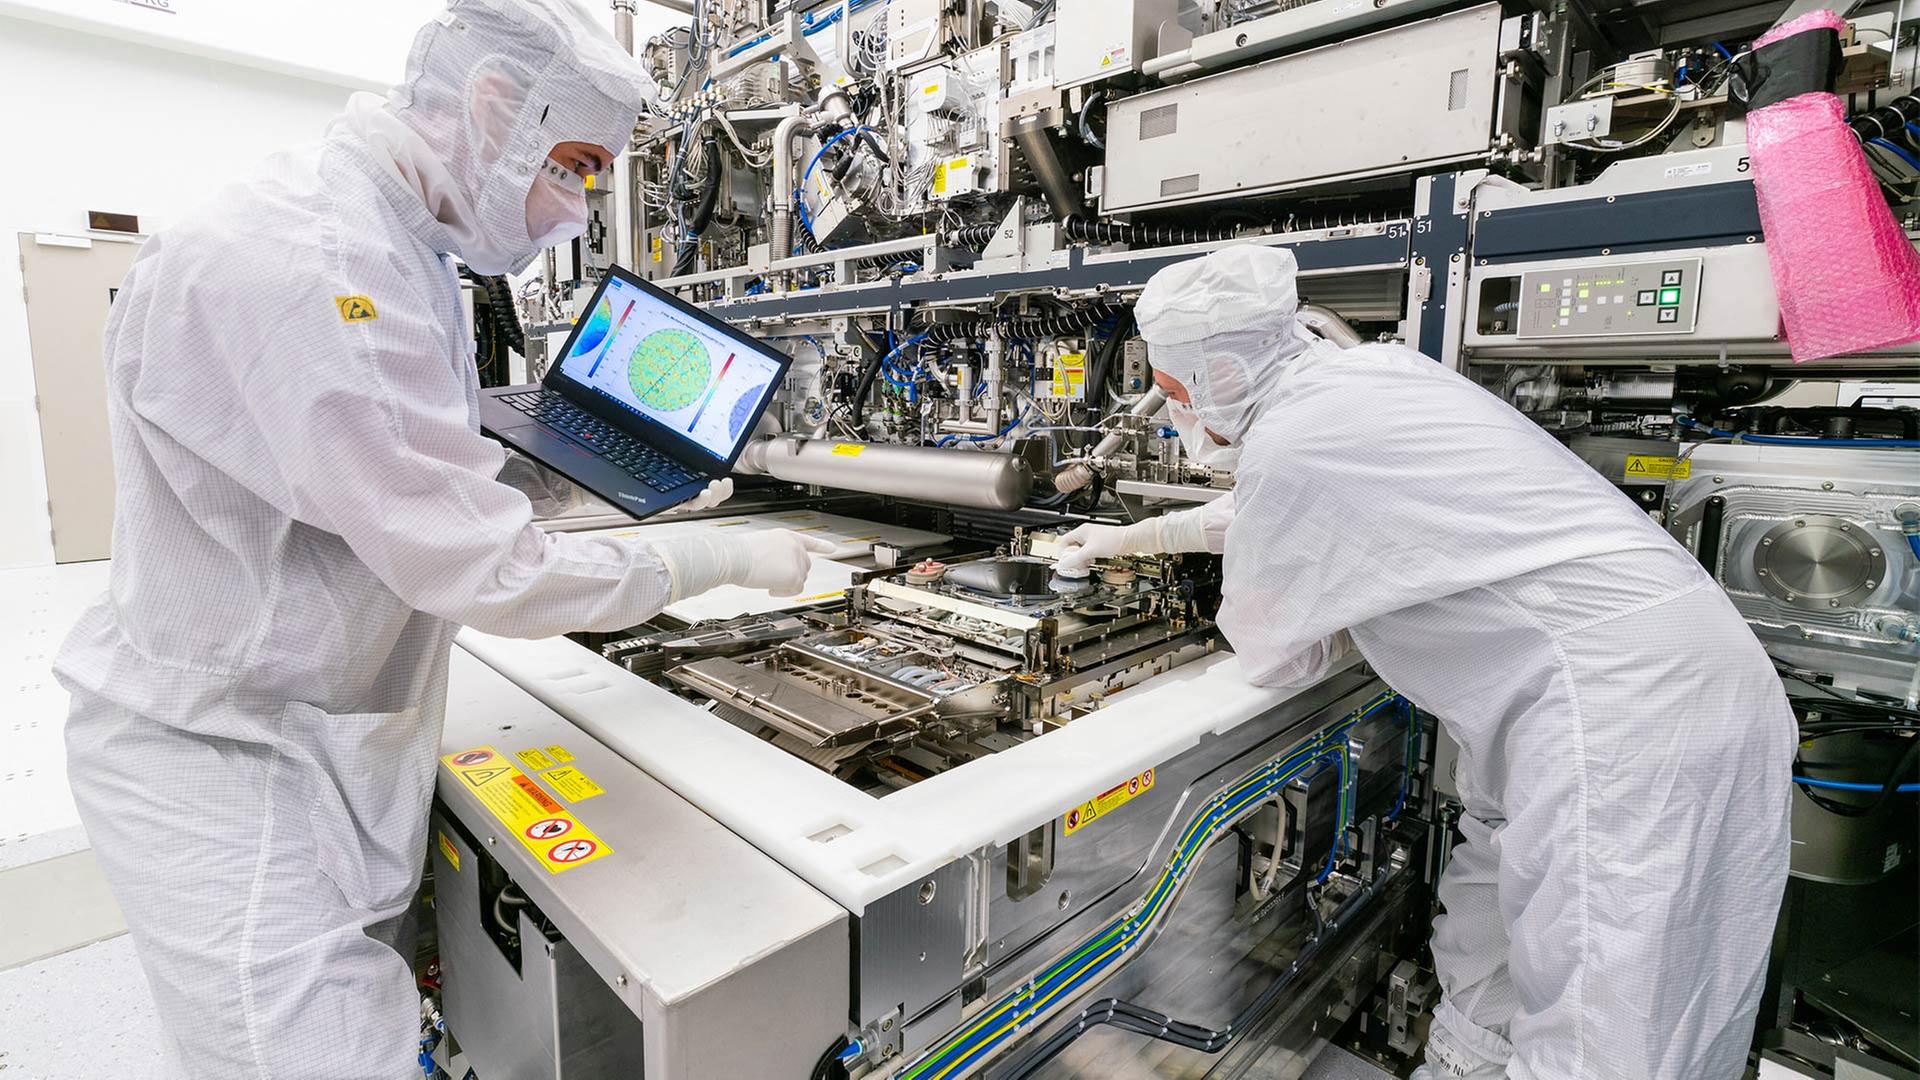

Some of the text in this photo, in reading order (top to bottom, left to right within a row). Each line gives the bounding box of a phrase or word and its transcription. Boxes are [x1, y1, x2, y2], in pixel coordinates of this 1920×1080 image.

[1388, 225, 1403, 239] 51
[1416, 219, 1432, 234] 51
[1004, 229, 1014, 239] 52
[618, 491, 647, 504] ThinkPad
[527, 786, 553, 807] WARNING
